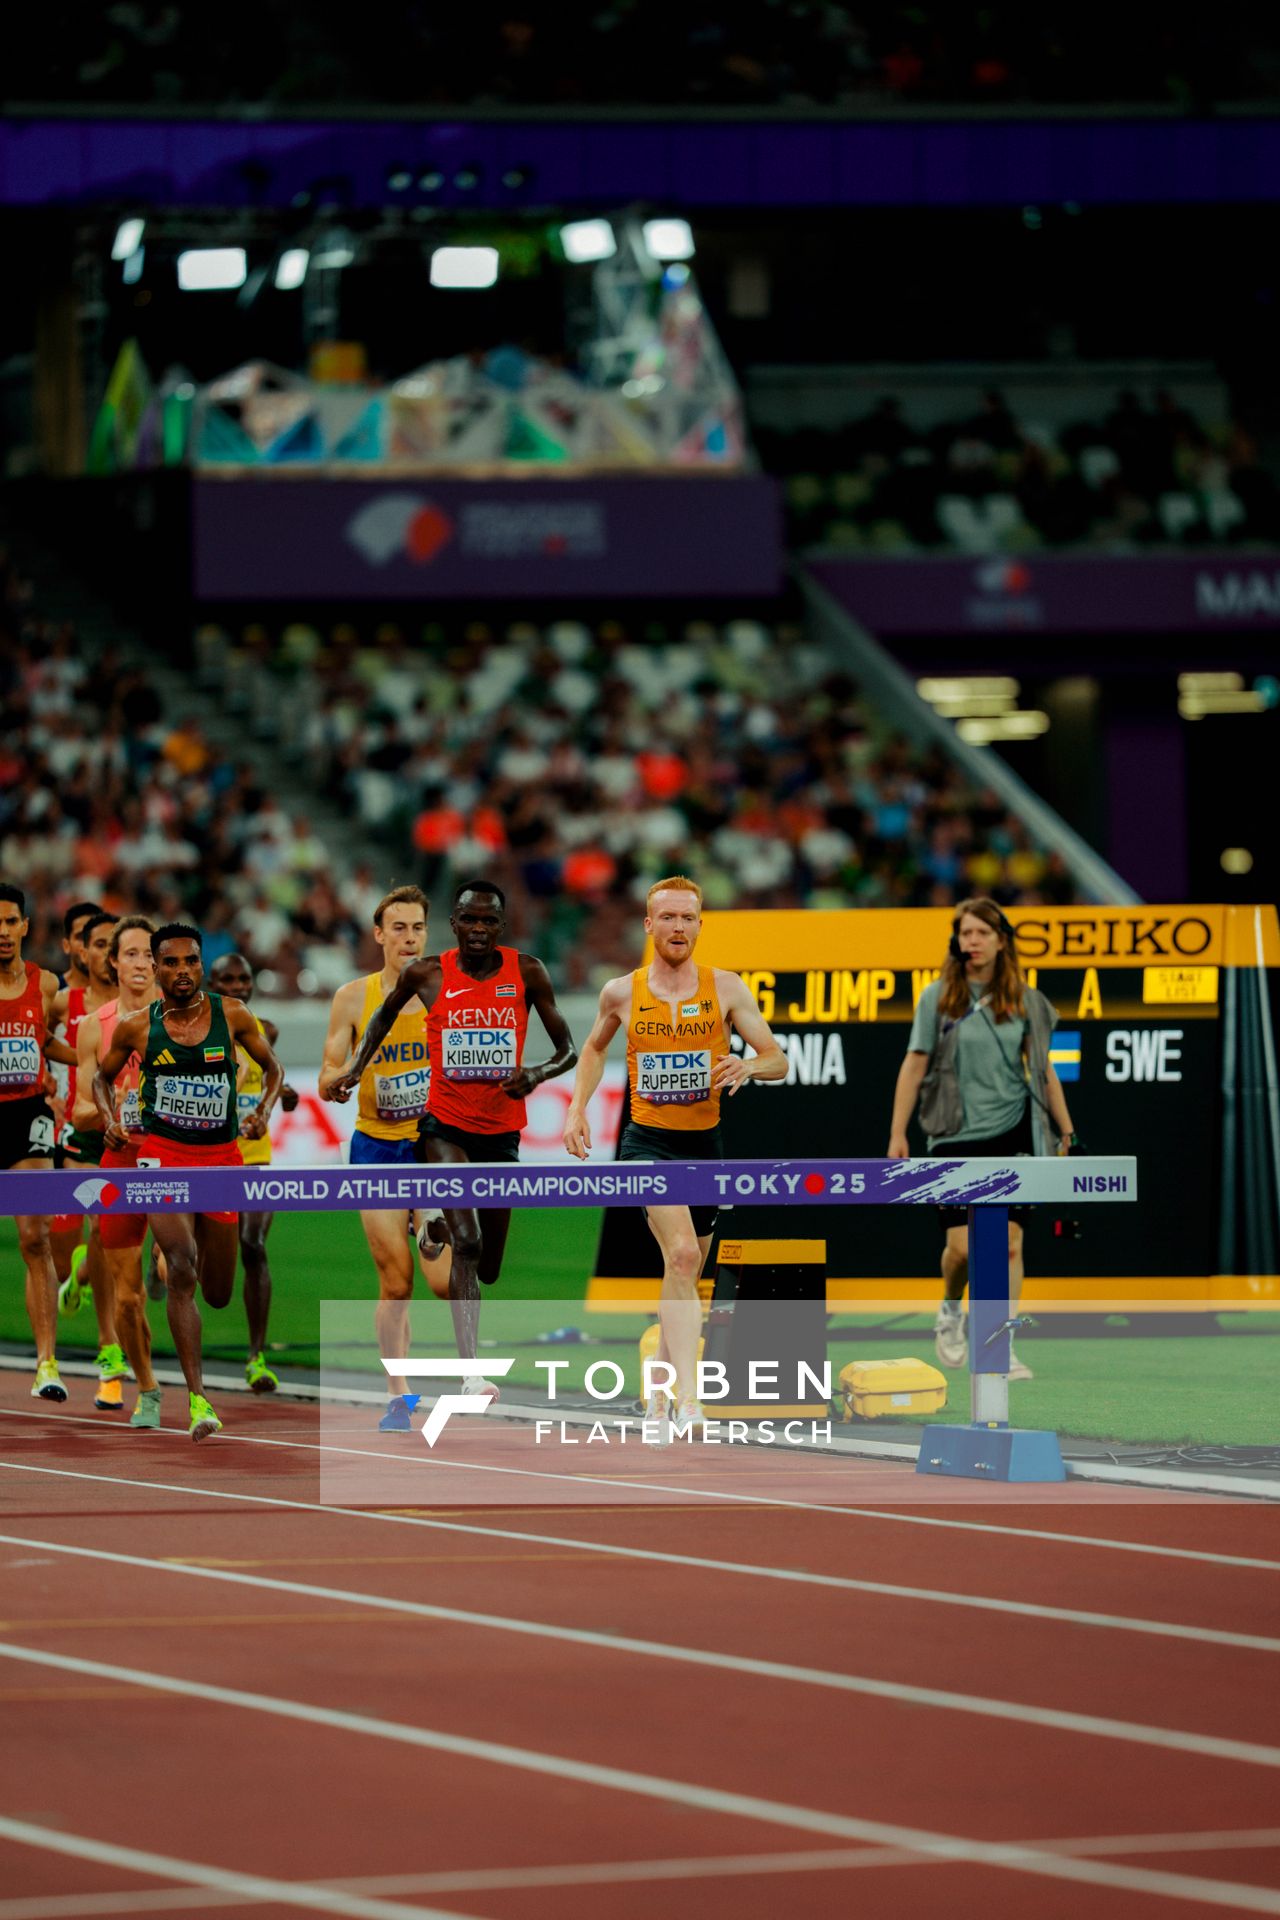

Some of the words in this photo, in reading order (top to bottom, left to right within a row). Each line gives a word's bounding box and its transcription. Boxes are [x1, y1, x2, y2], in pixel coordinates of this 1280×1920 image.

[1014, 917, 1212, 957] SEIKO
[788, 969, 896, 1022] JUMP
[1077, 967, 1103, 1019] A
[447, 1007, 518, 1027] KENYA
[635, 1020, 716, 1037] GERMANY
[462, 1031, 511, 1046] TDK
[447, 1049, 513, 1066] KIBIWOT
[655, 1052, 706, 1070] TDK
[1105, 1029, 1184, 1082] SWE
[390, 1067, 432, 1090] TDK
[642, 1071, 708, 1090] RUPPERT
[177, 1080, 225, 1099] TDK
[159, 1096, 224, 1118] FIREWU
[125, 1188, 190, 1196] CHAMPIONSHIPS
[242, 1180, 330, 1201] WORLD
[336, 1178, 464, 1199] ATHLETICS
[471, 1175, 668, 1198] CHAMPIONSHIPS
[1072, 1175, 1128, 1193] NISHI
